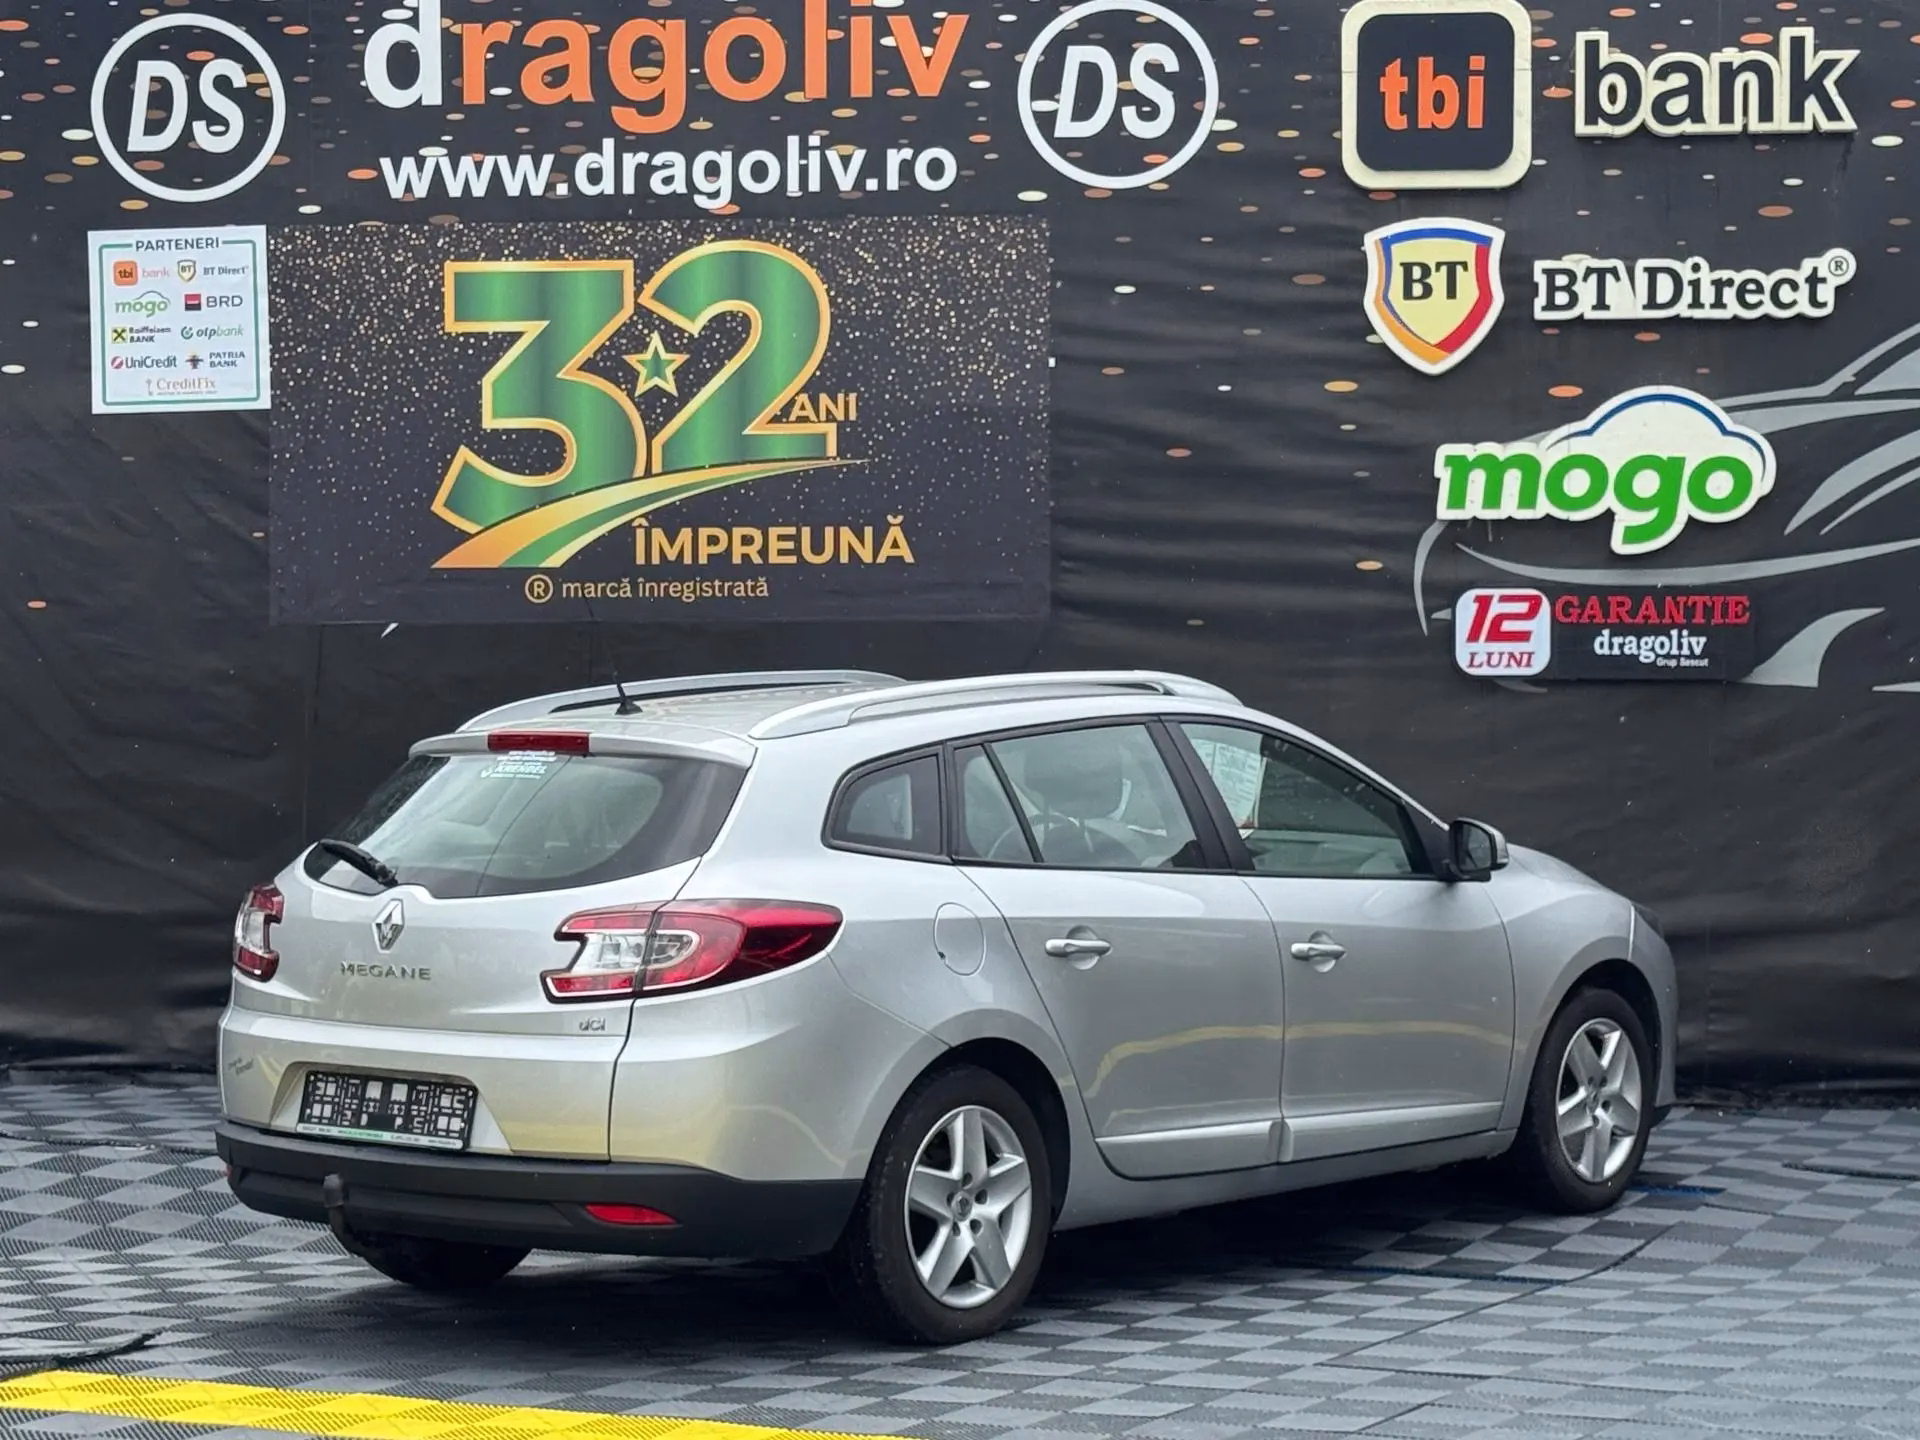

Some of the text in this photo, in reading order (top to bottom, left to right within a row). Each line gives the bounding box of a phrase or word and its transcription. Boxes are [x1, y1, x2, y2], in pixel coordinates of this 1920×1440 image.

[363, 0, 969, 134] dragoliv
[1054, 42, 1180, 140] DS
[1379, 27, 1860, 138] tbi bank
[127, 58, 249, 153] DS
[379, 134, 958, 209] www.dragoliv.ro
[135, 236, 220, 252] PARTENERI
[117, 269, 135, 279] tbi
[203, 267, 215, 275] BT
[1400, 259, 1469, 301] BT
[1540, 265, 1622, 313] BT
[115, 300, 168, 318] mogo
[206, 295, 243, 308] BRD
[129, 335, 155, 343] BANK
[125, 355, 177, 369] UniCredit
[209, 351, 245, 359] PATRIA
[209, 360, 238, 368] BANK
[157, 377, 216, 390] CreditFix
[430, 239, 838, 534] 32
[789, 393, 857, 421] ANI
[1443, 453, 1753, 545] mogo
[631, 515, 915, 565] ÎMPREUNĂ
[561, 577, 632, 599] marcă
[638, 578, 769, 602] înregistrată
[1466, 594, 1750, 644] 12 GARANTIE
[1593, 628, 1707, 663] dragoliv
[1467, 652, 1534, 669] LUNI
[340, 960, 431, 981] MEGANE
